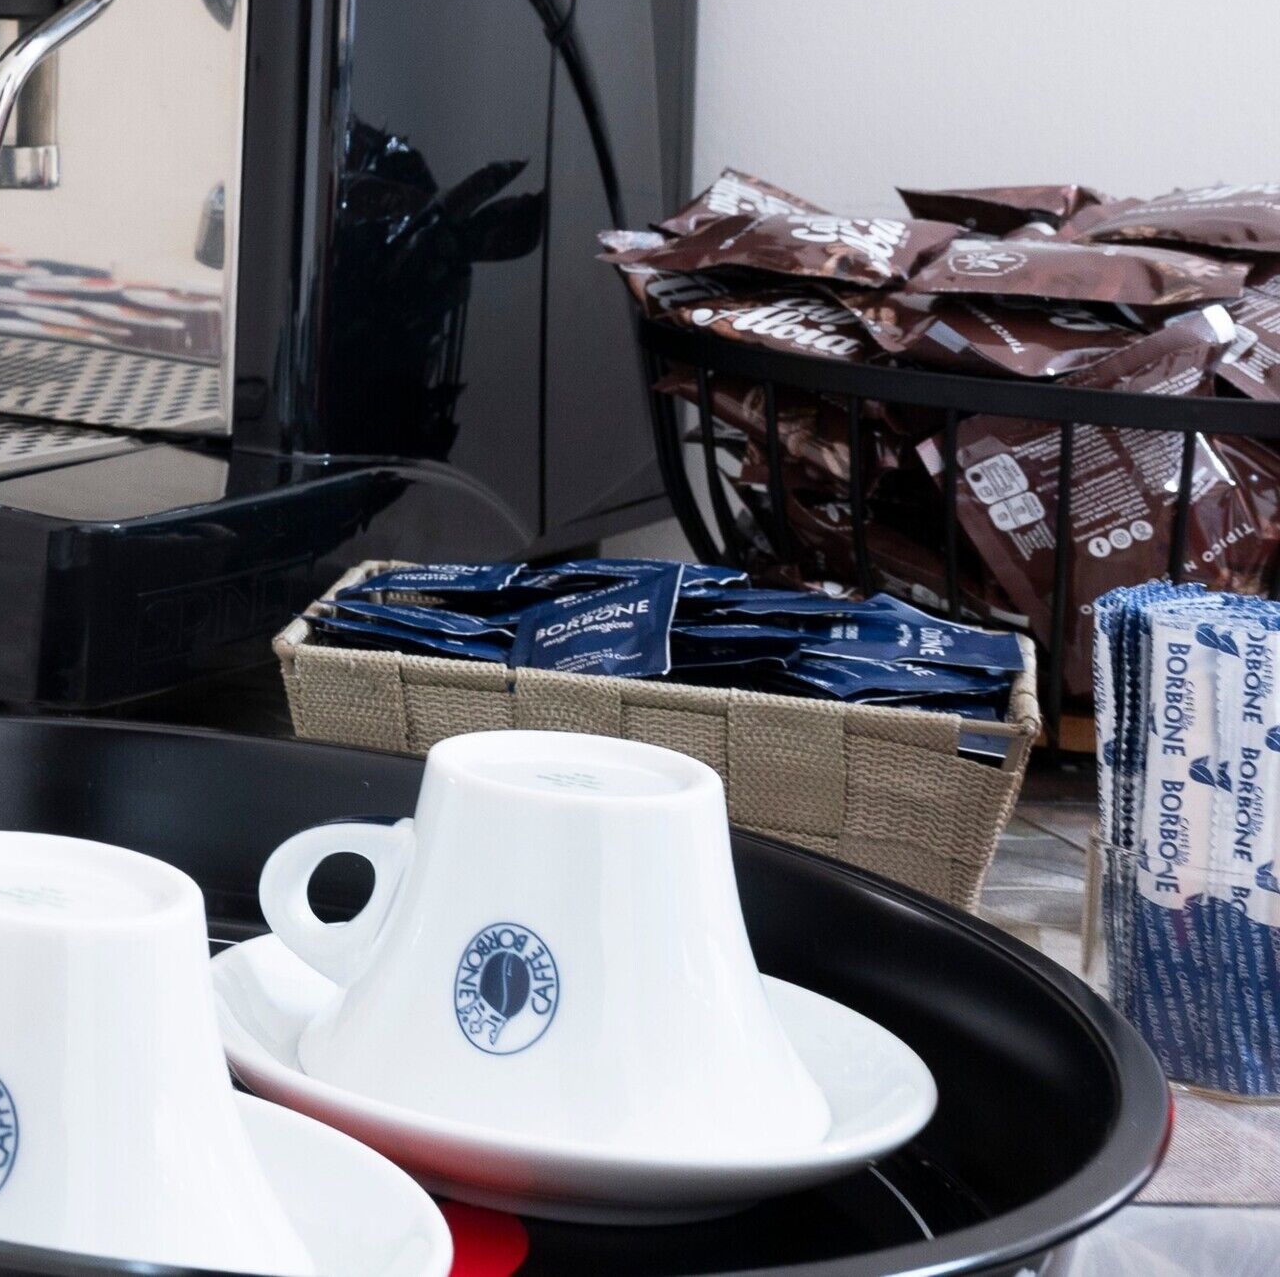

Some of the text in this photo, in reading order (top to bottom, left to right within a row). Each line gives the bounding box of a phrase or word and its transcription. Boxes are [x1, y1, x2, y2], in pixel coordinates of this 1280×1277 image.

[535, 598, 650, 642] BORBONE
[1162, 641, 1190, 758] BORBONE
[1155, 779, 1185, 895] BORBONE
[1233, 747, 1262, 863] BORBONE
[458, 928, 555, 1016] CAFFÈ BORBONE
